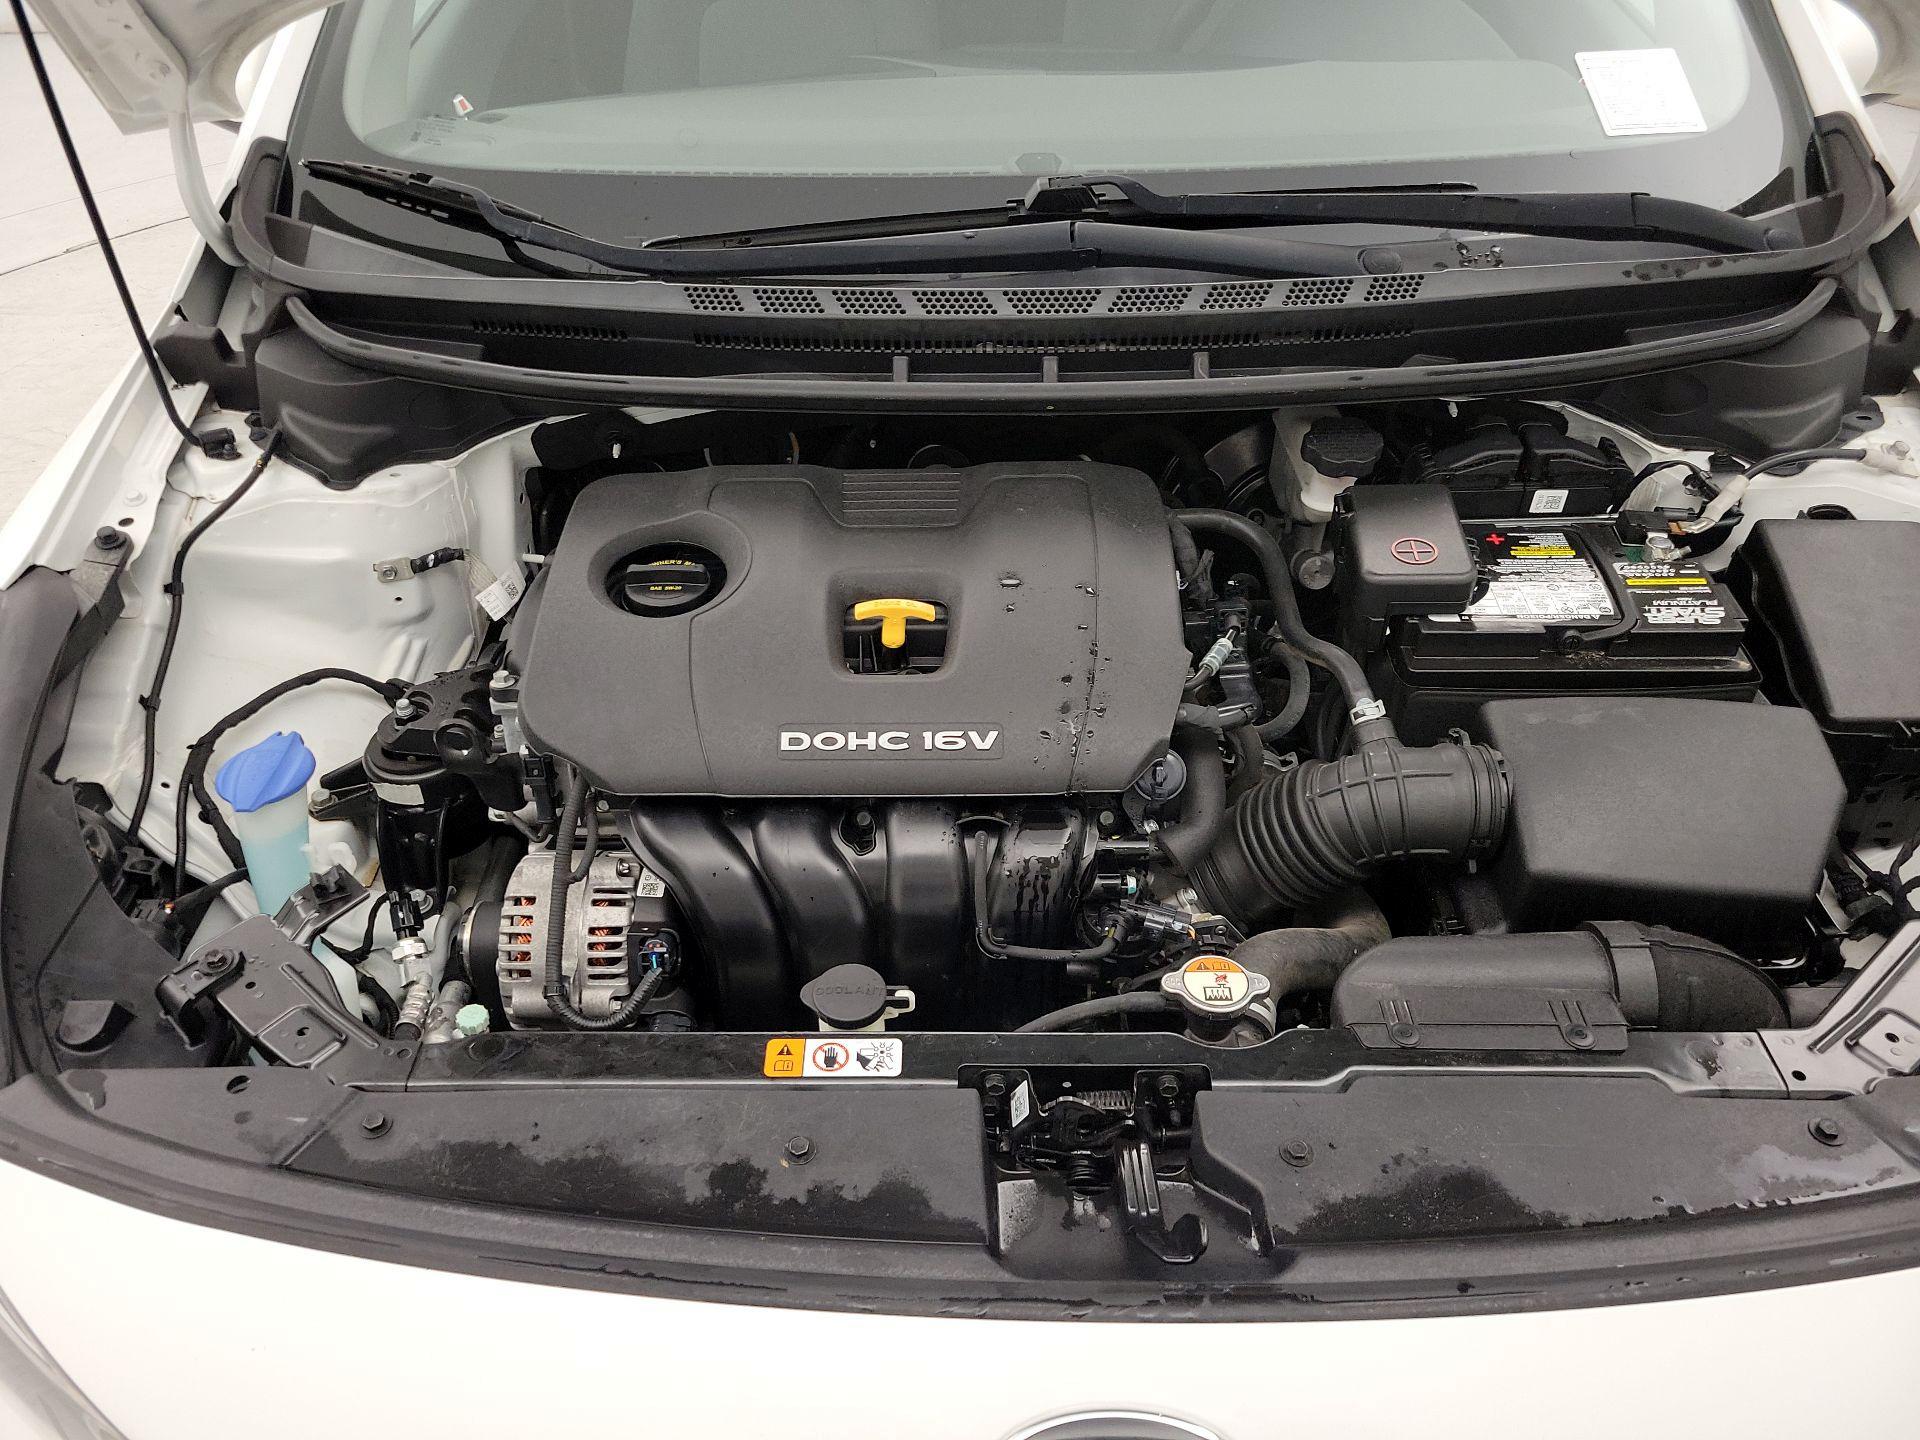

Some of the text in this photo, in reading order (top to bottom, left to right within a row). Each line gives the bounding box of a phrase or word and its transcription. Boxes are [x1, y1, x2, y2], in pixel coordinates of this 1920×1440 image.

[1643, 607, 1726, 617] START
[1647, 615, 1722, 625] SUPER
[780, 730, 999, 751] DOHC 16V
[815, 984, 885, 997] COOLANT
